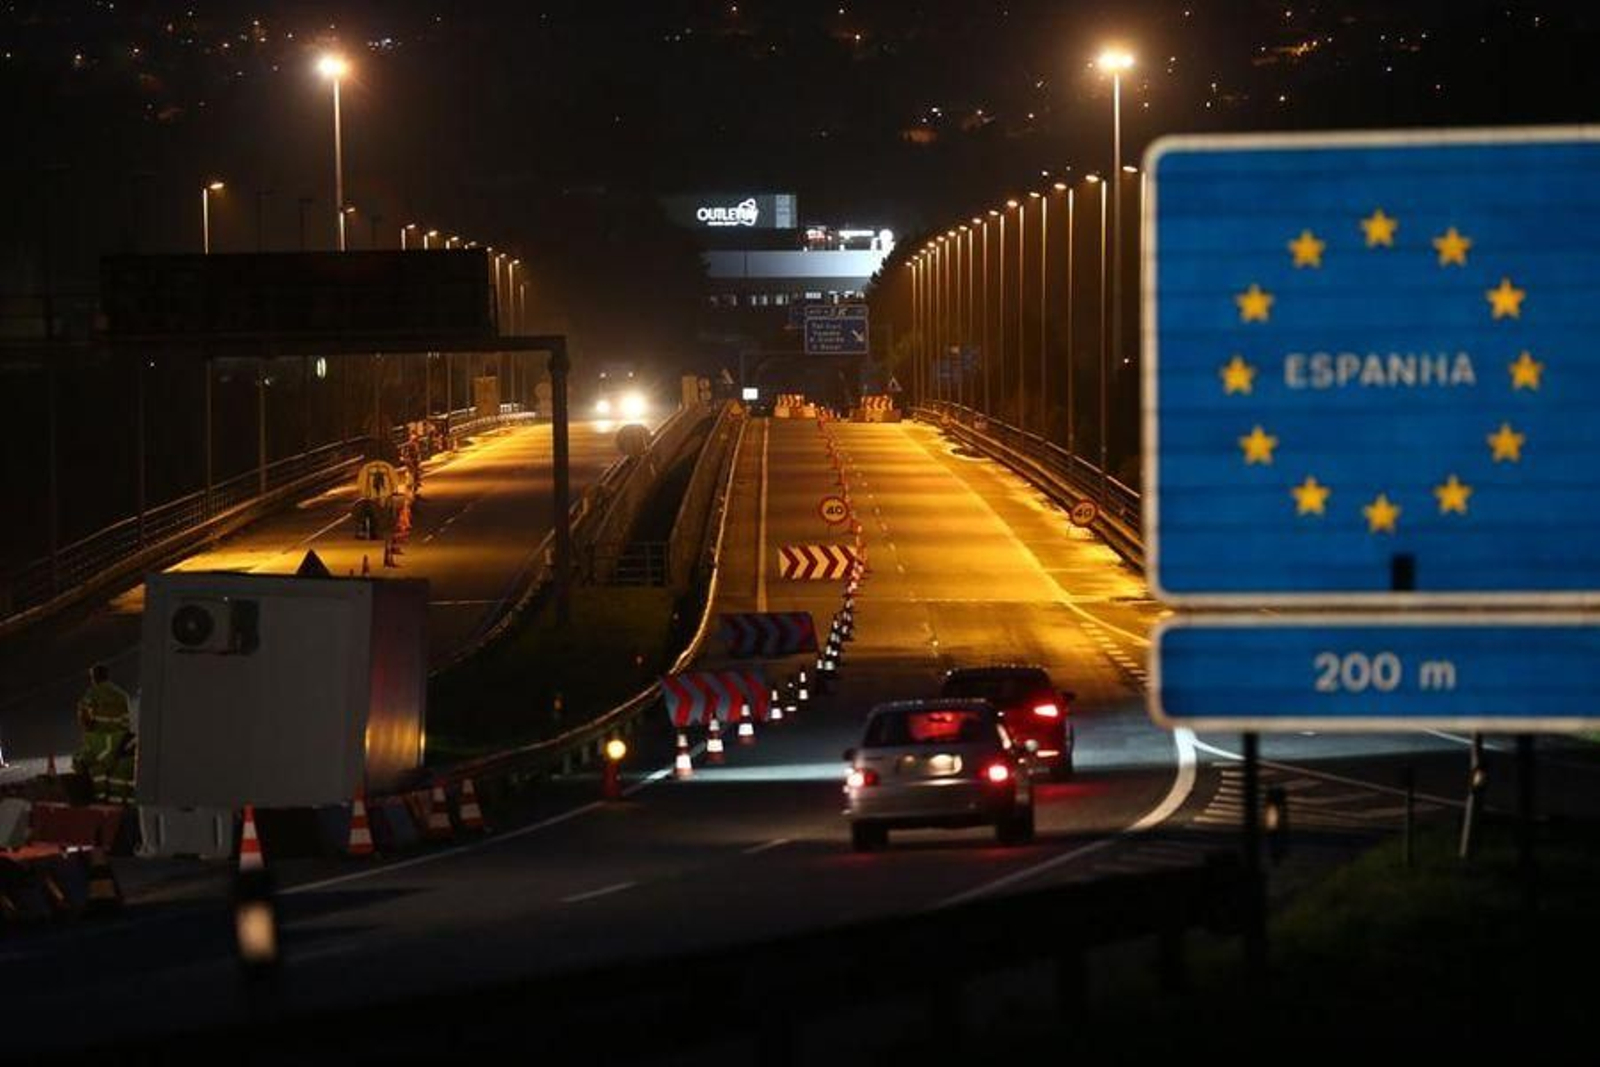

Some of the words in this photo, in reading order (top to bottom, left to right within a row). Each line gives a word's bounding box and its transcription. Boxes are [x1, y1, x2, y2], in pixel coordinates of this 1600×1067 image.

[1284, 353, 1476, 389] ESPANHA
[826, 504, 843, 515] 40
[1074, 506, 1092, 518] 40
[1314, 651, 1402, 692] 200
[1419, 660, 1456, 690] m
